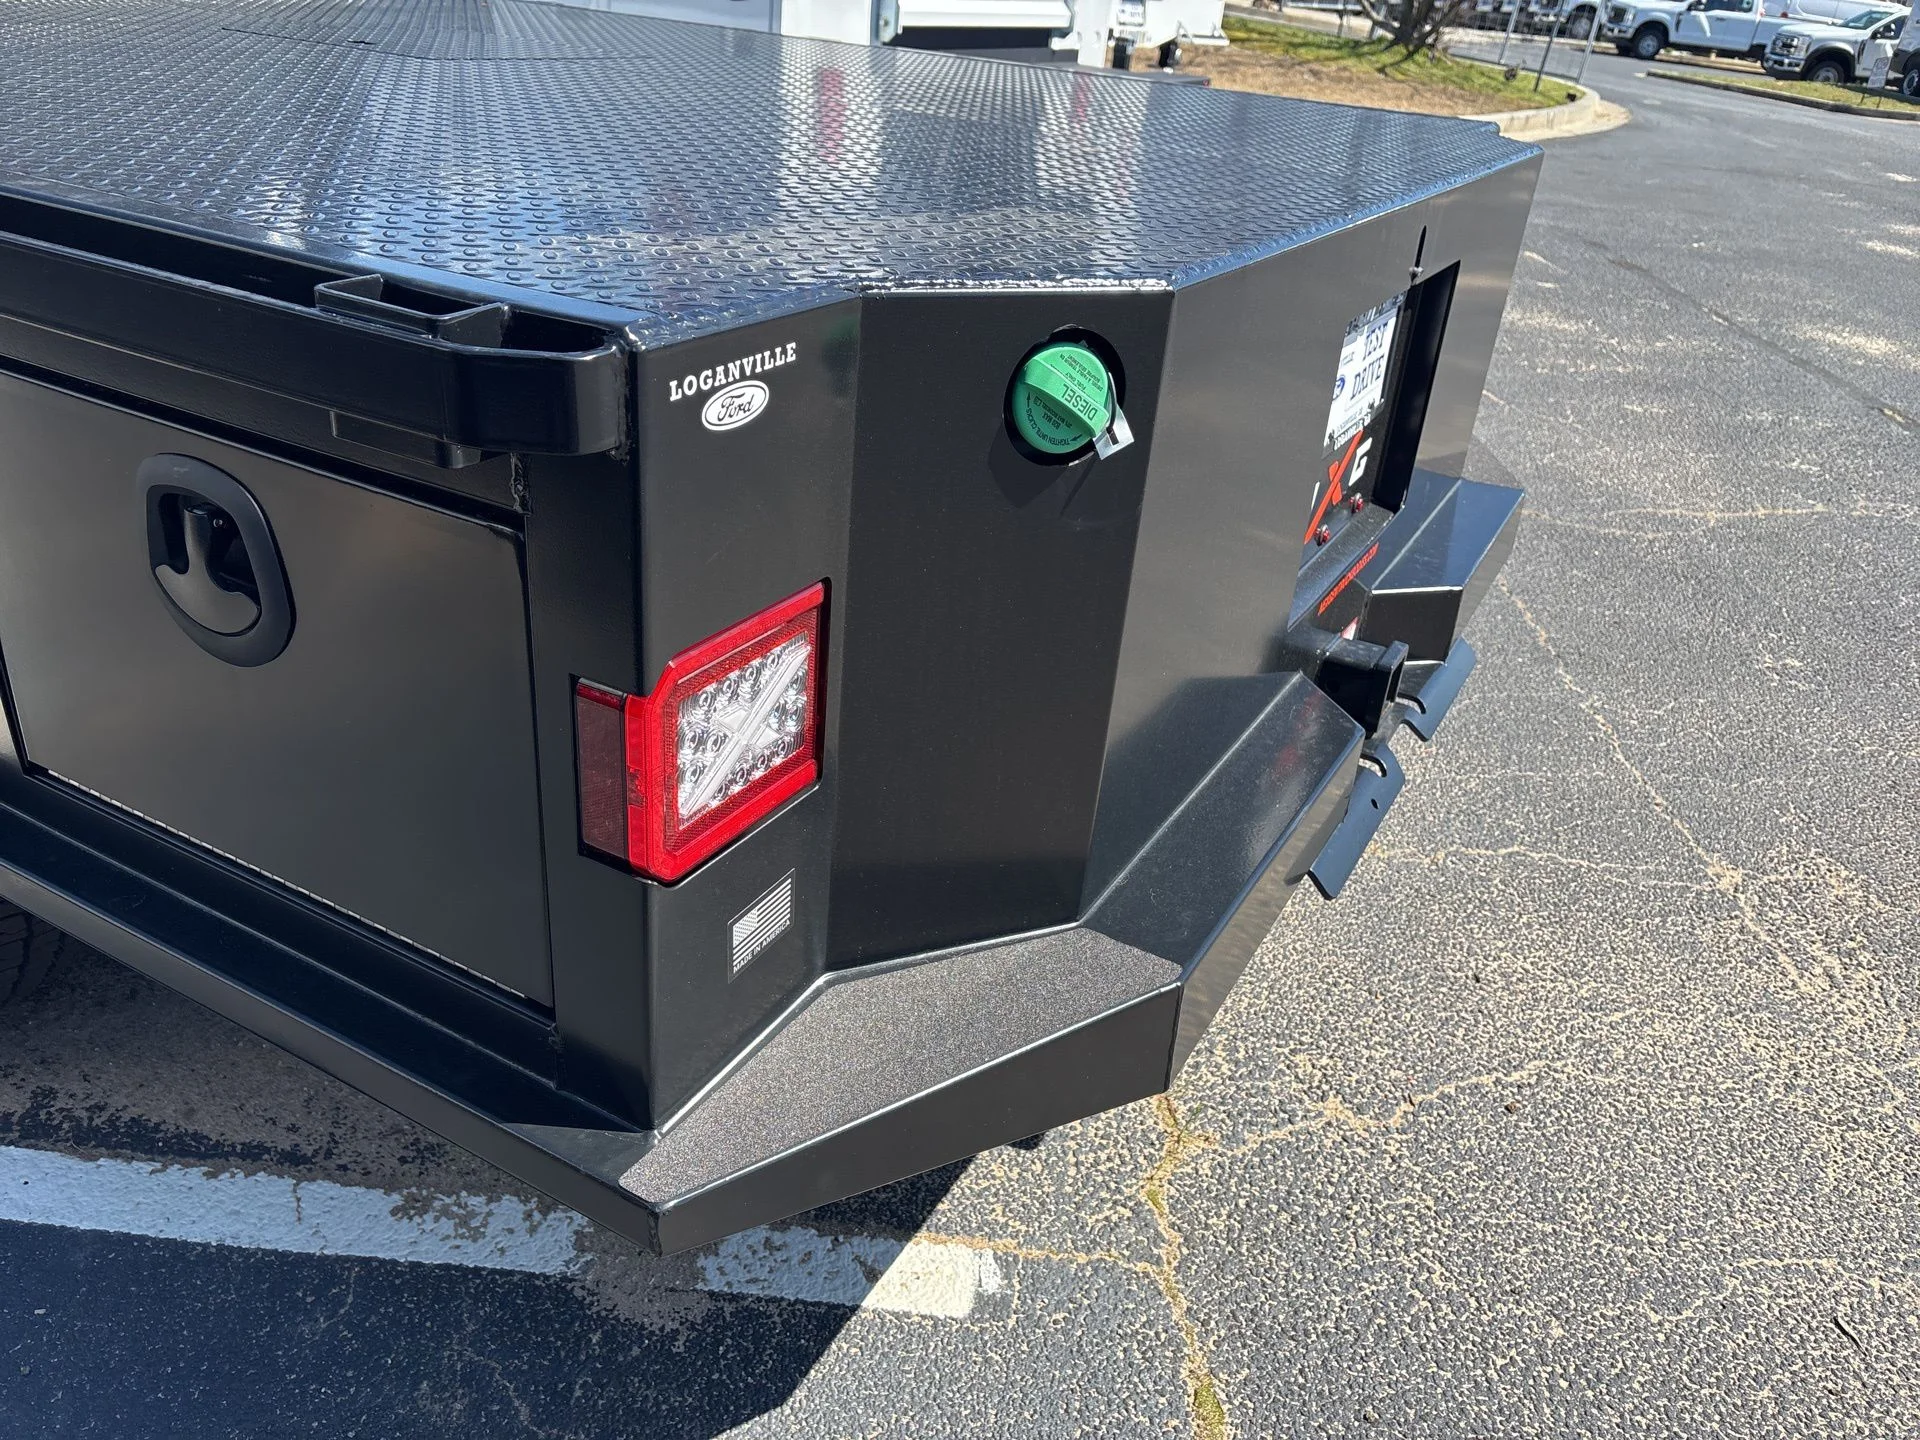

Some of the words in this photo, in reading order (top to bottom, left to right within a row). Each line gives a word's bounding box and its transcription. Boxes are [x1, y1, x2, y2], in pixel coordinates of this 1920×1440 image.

[1362, 320, 1388, 362] TEST
[669, 342, 797, 402] LOGANVILLE
[1350, 353, 1385, 400] DRIVE
[717, 392, 755, 422] Ford
[1062, 385, 1098, 420] DIESEL
[1047, 437, 1070, 446] TIGHTEN
[733, 952, 752, 974] MADE
[753, 944, 761, 955] IN
[762, 919, 790, 948] AMERICA
